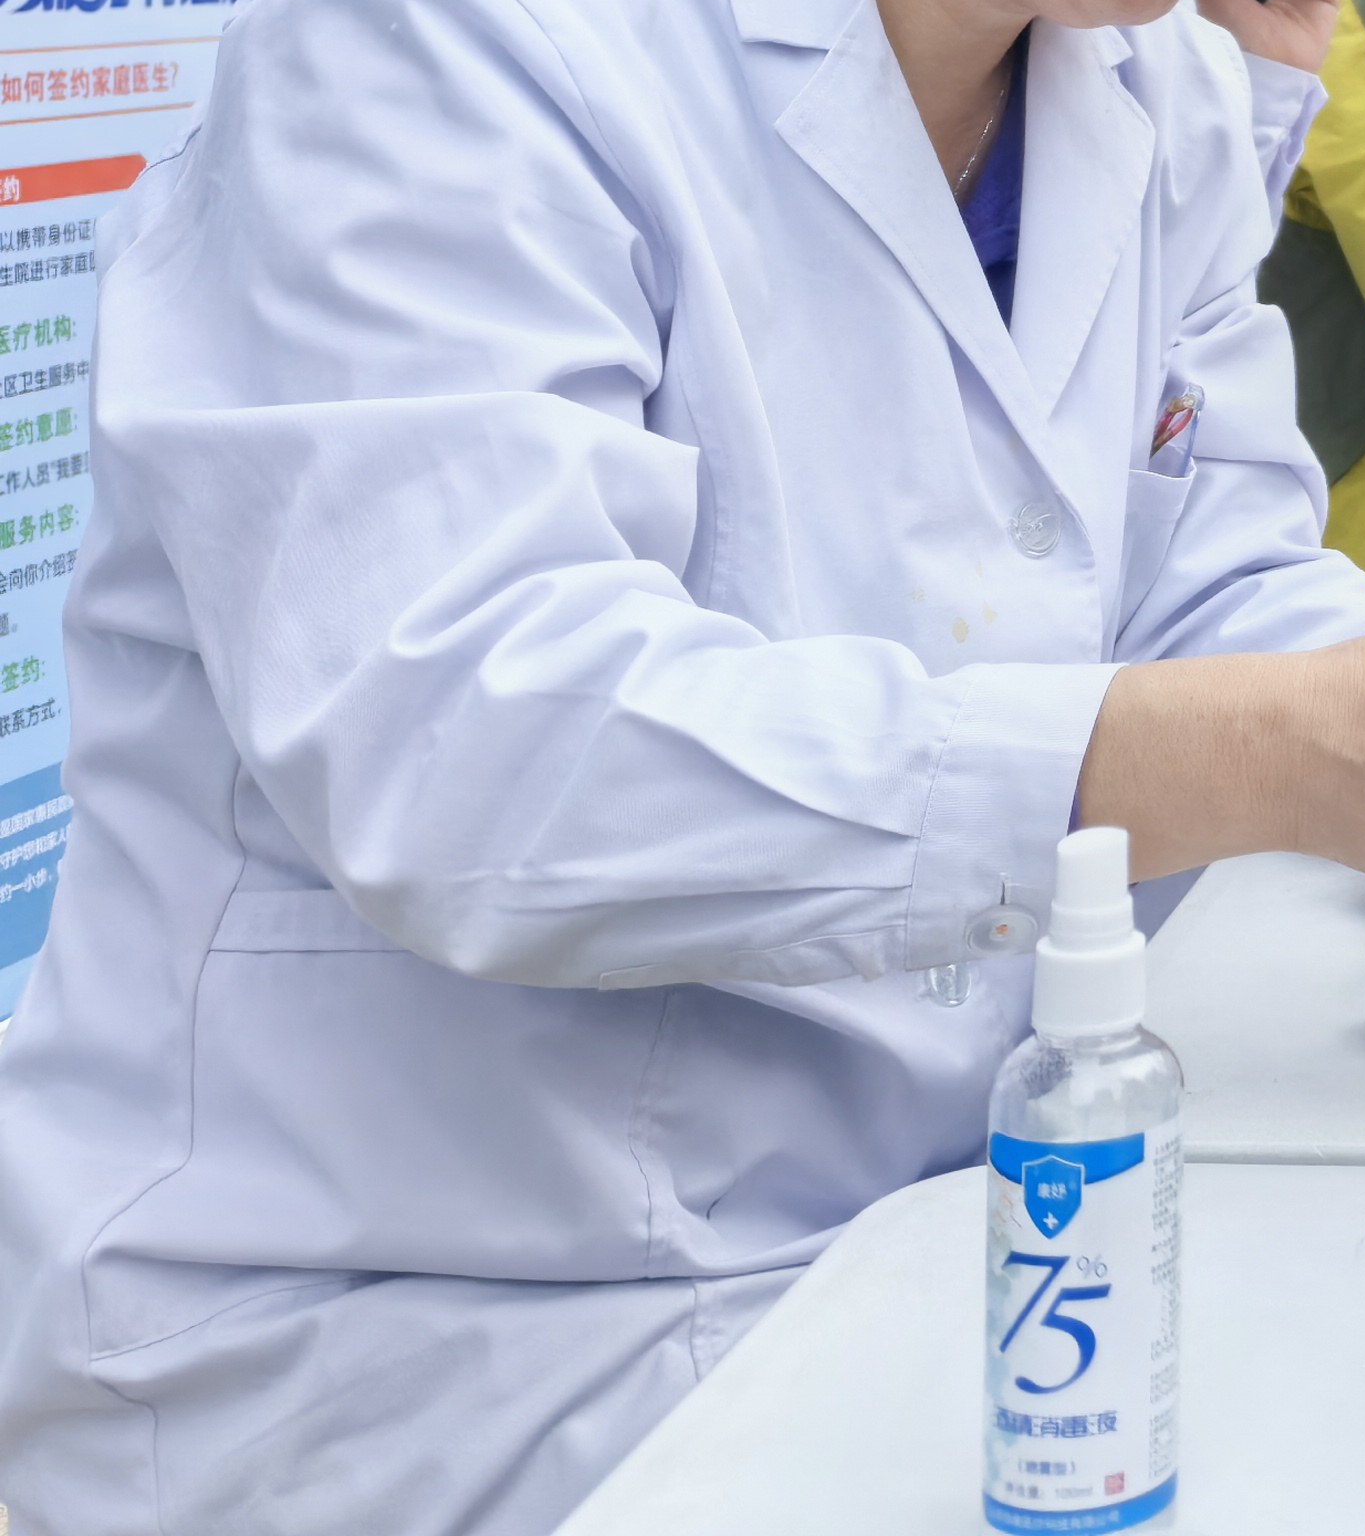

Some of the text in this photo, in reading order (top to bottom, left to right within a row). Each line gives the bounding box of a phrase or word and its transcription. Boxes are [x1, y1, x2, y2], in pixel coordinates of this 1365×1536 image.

[0, 174, 20, 203] 约
[0, 360, 89, 399] 区卫生服务中
